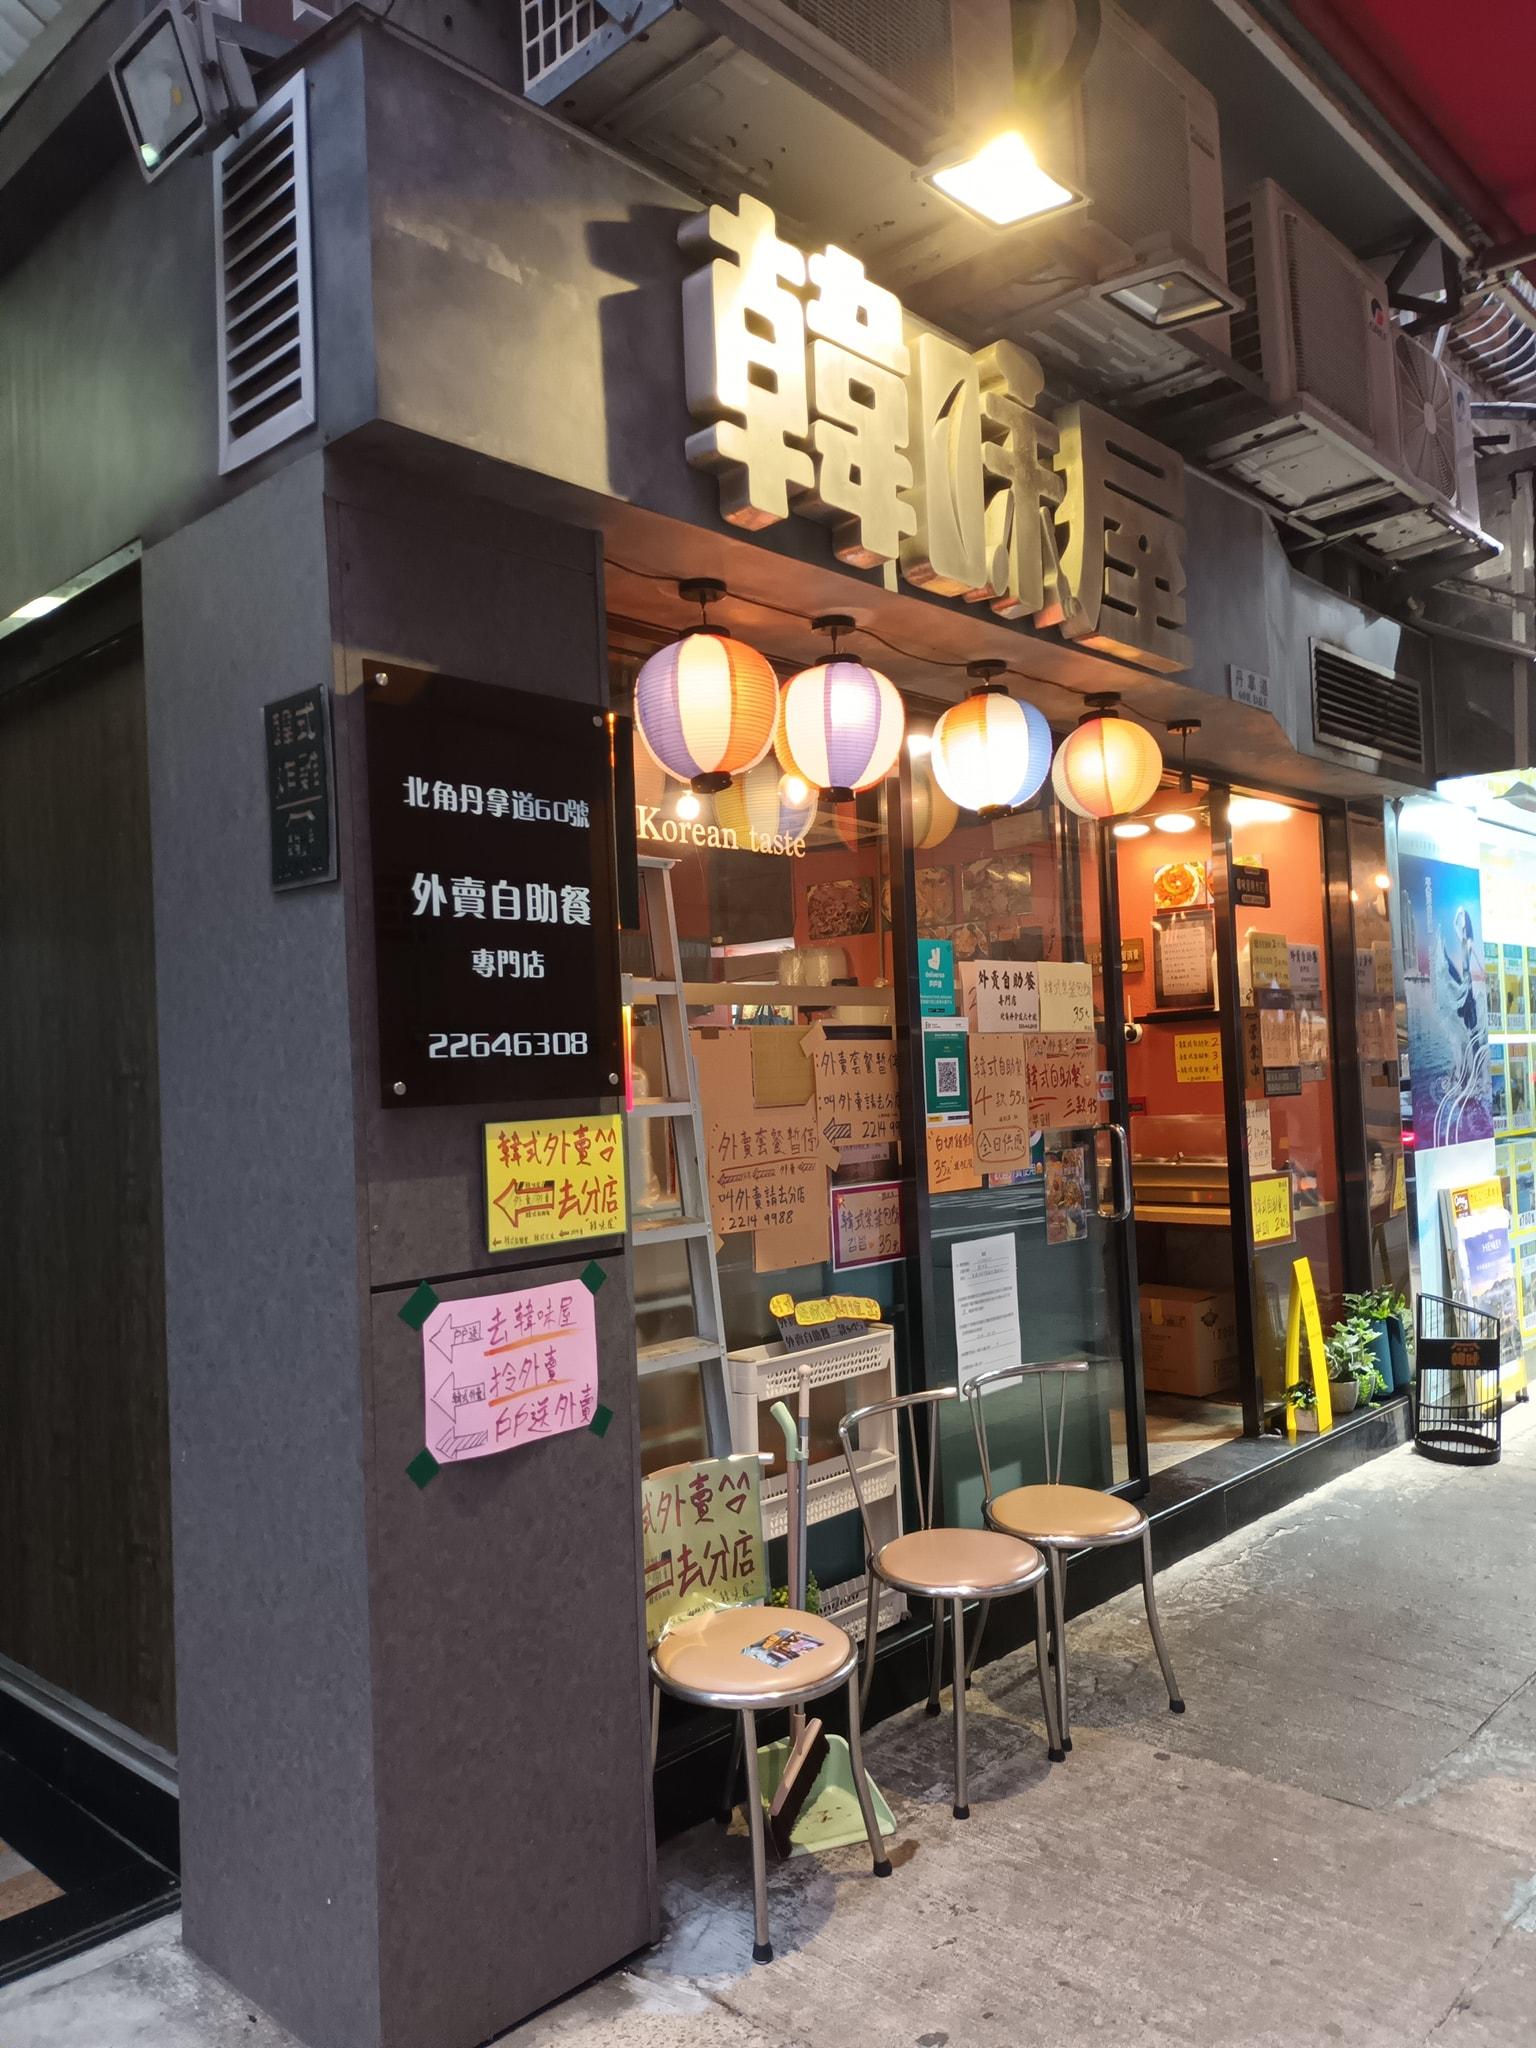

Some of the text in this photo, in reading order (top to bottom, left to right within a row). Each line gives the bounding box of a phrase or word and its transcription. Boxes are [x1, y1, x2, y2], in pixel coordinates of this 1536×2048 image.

[402, 775, 590, 828] 北角丹拿道60號
[636, 804, 806, 858] Korean taste
[411, 872, 591, 925] 外賣自助餐
[471, 949, 544, 979] 專門店
[978, 969, 1036, 991] 外賣自助餐
[429, 1032, 588, 1058] 22646308
[497, 1124, 592, 1168] 韓式外賣
[718, 1128, 819, 1160] 外賣套餐暫停
[862, 1121, 886, 1138] 2214
[559, 1175, 618, 1219] 去分店
[728, 1210, 794, 1230] 2214 9988
[487, 1296, 577, 1346] 去韓味屋
[677, 1529, 756, 1598] 去分店
